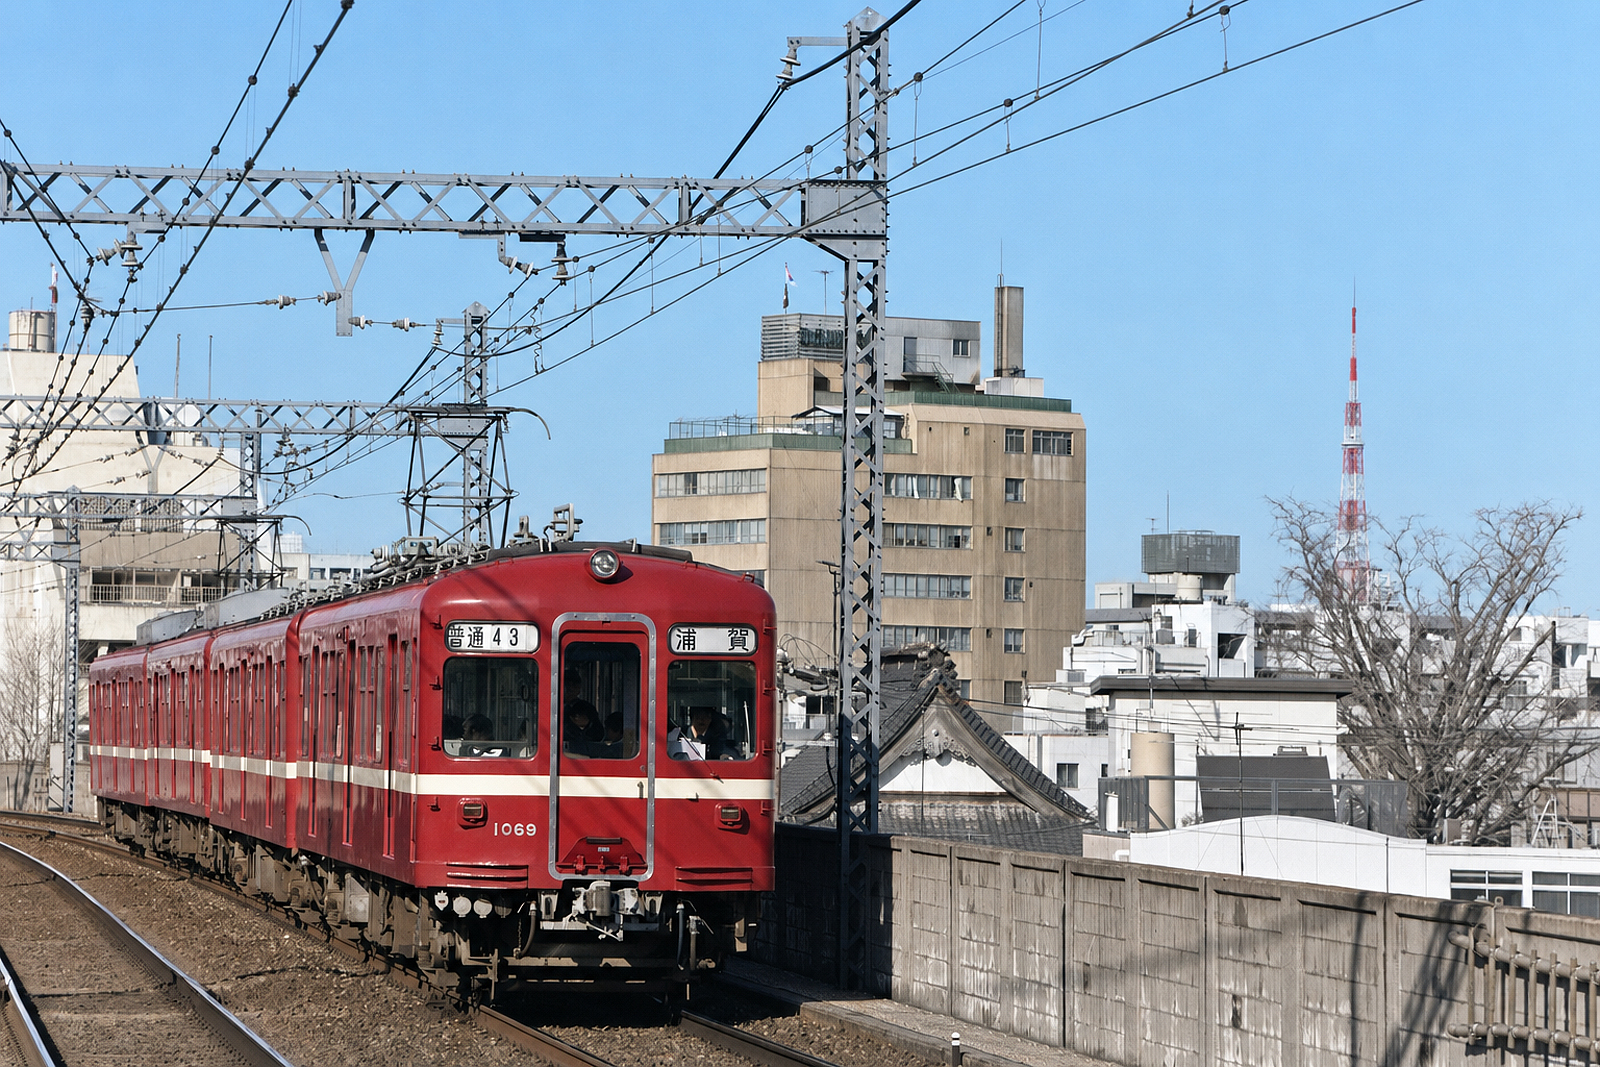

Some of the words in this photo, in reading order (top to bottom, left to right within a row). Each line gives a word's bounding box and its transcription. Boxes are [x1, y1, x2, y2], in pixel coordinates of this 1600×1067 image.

[448, 625, 484, 649] 普通
[492, 627, 519, 647] 43
[676, 627, 749, 652] 浦賀
[493, 822, 537, 837] 1069
